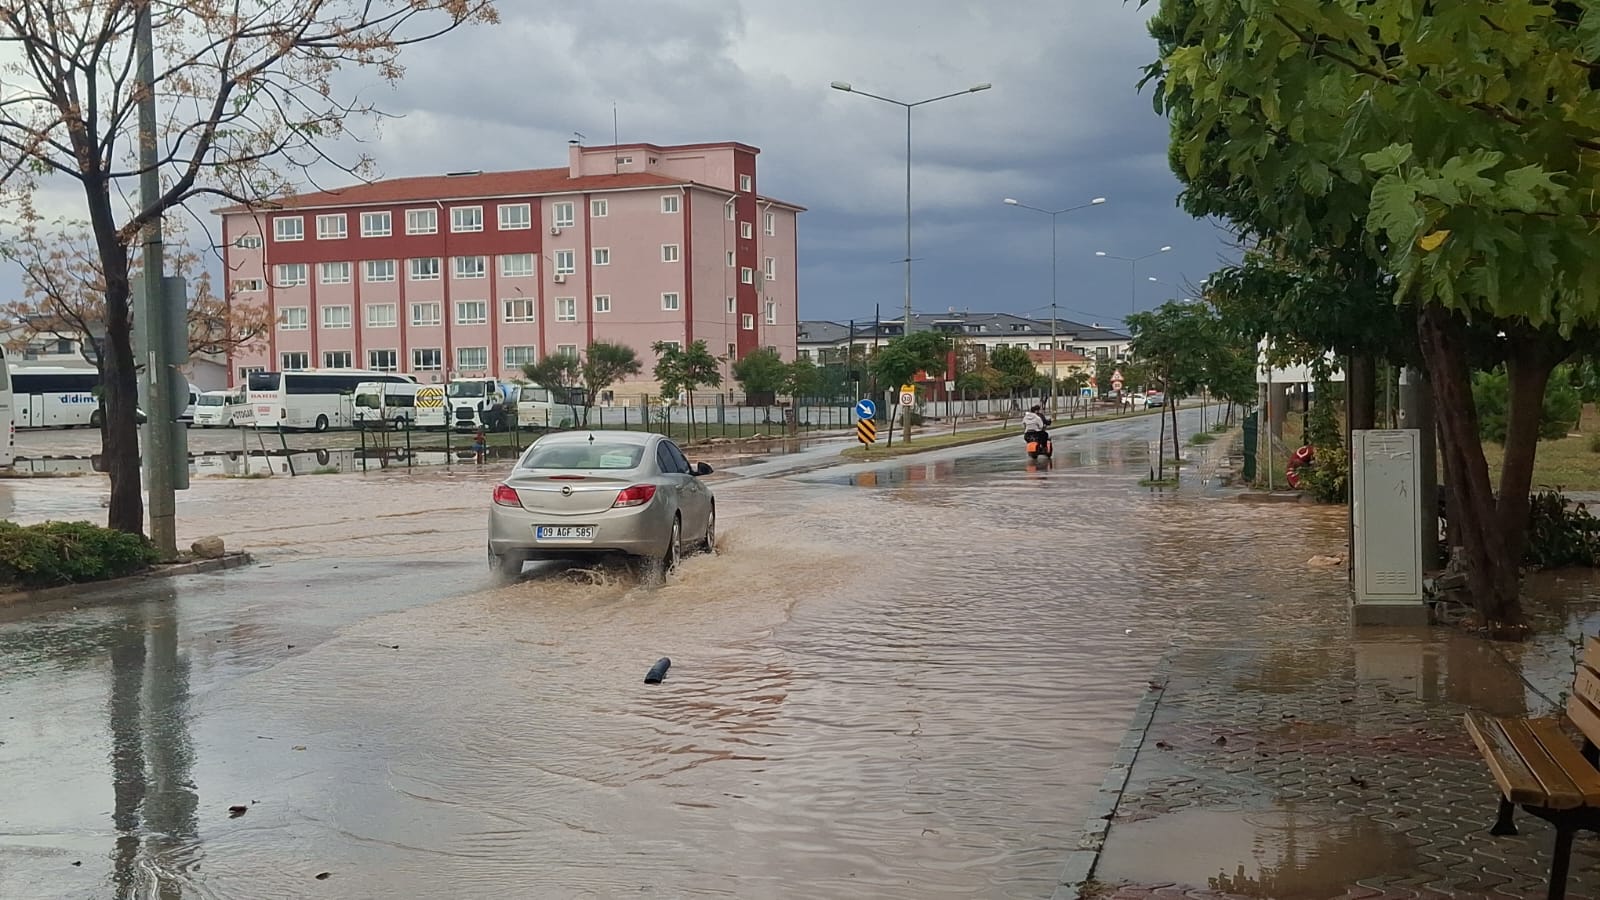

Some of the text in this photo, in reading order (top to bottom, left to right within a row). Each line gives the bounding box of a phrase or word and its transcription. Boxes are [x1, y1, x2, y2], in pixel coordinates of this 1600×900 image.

[543, 527, 591, 537] 09 AGF 585
